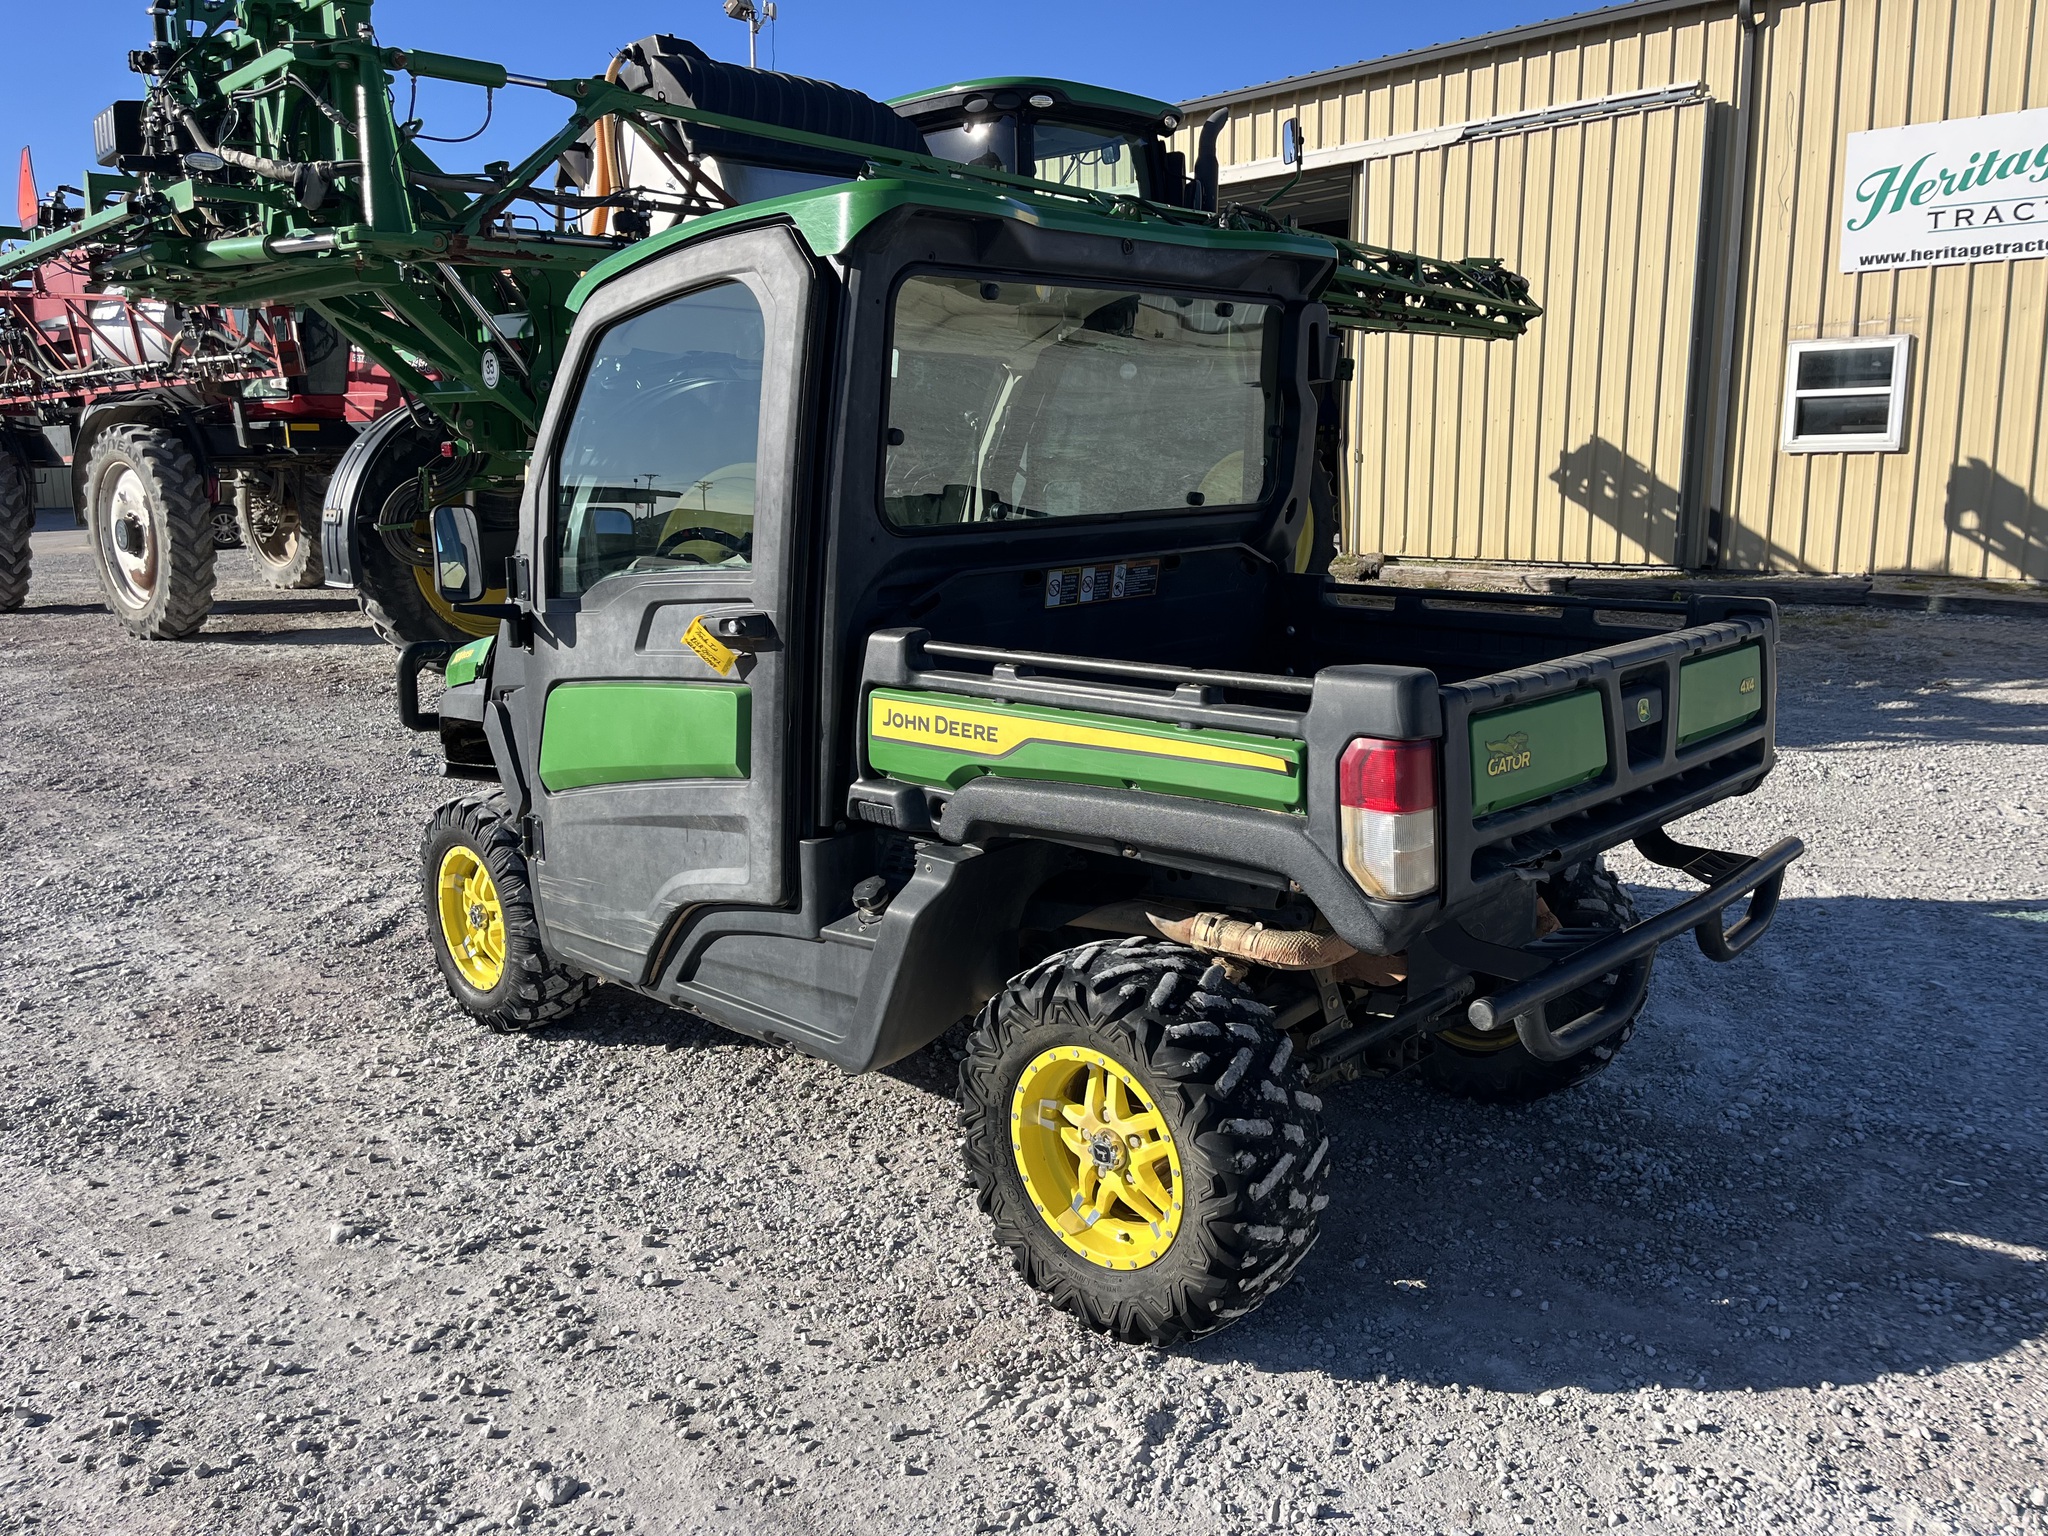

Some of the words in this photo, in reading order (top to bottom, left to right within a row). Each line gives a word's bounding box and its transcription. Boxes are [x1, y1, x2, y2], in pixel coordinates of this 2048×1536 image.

[486, 360, 495, 375] 35
[882, 708, 930, 733] JOHN
[934, 715, 999, 743] DEERE
[1487, 751, 1531, 777] GATOR
